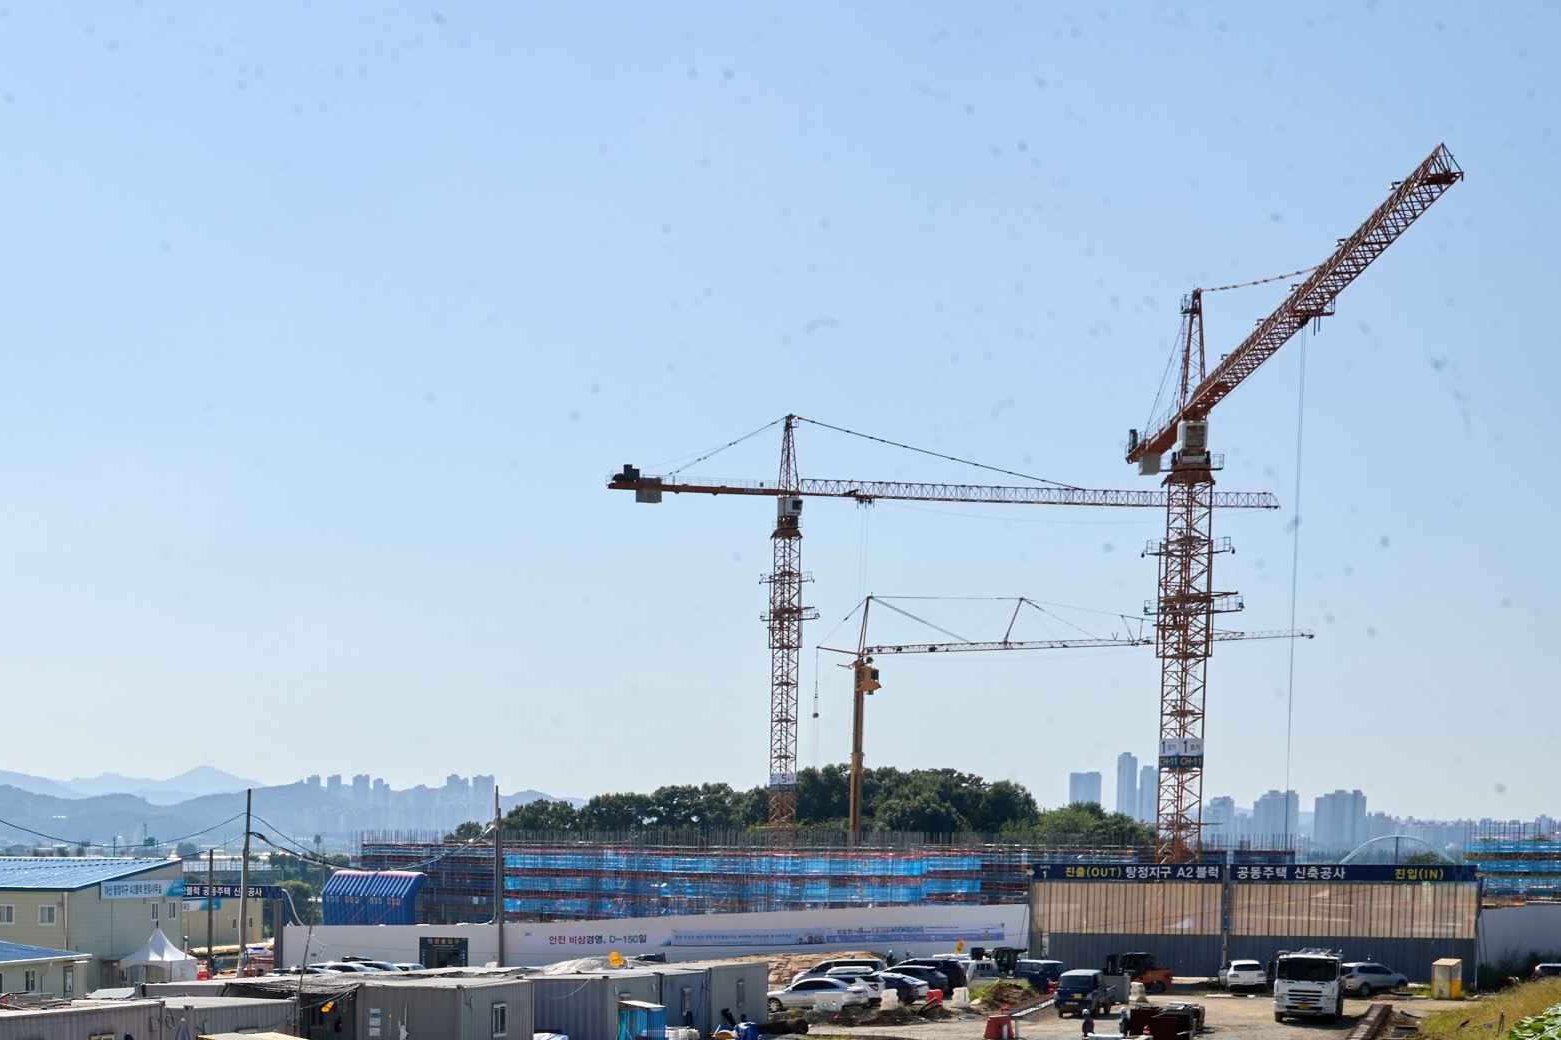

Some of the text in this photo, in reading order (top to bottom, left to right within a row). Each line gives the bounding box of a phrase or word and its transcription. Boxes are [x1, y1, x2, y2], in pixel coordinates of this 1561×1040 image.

[1065, 866, 1121, 879] 진출(OUT)
[1125, 866, 1172, 879] 탕정지구
[1237, 866, 1346, 880] 공동주택 신축공사
[1395, 868, 1444, 881] 진입(IN)
[233, 887, 262, 897] 신공사
[549, 935, 565, 945] 안전
